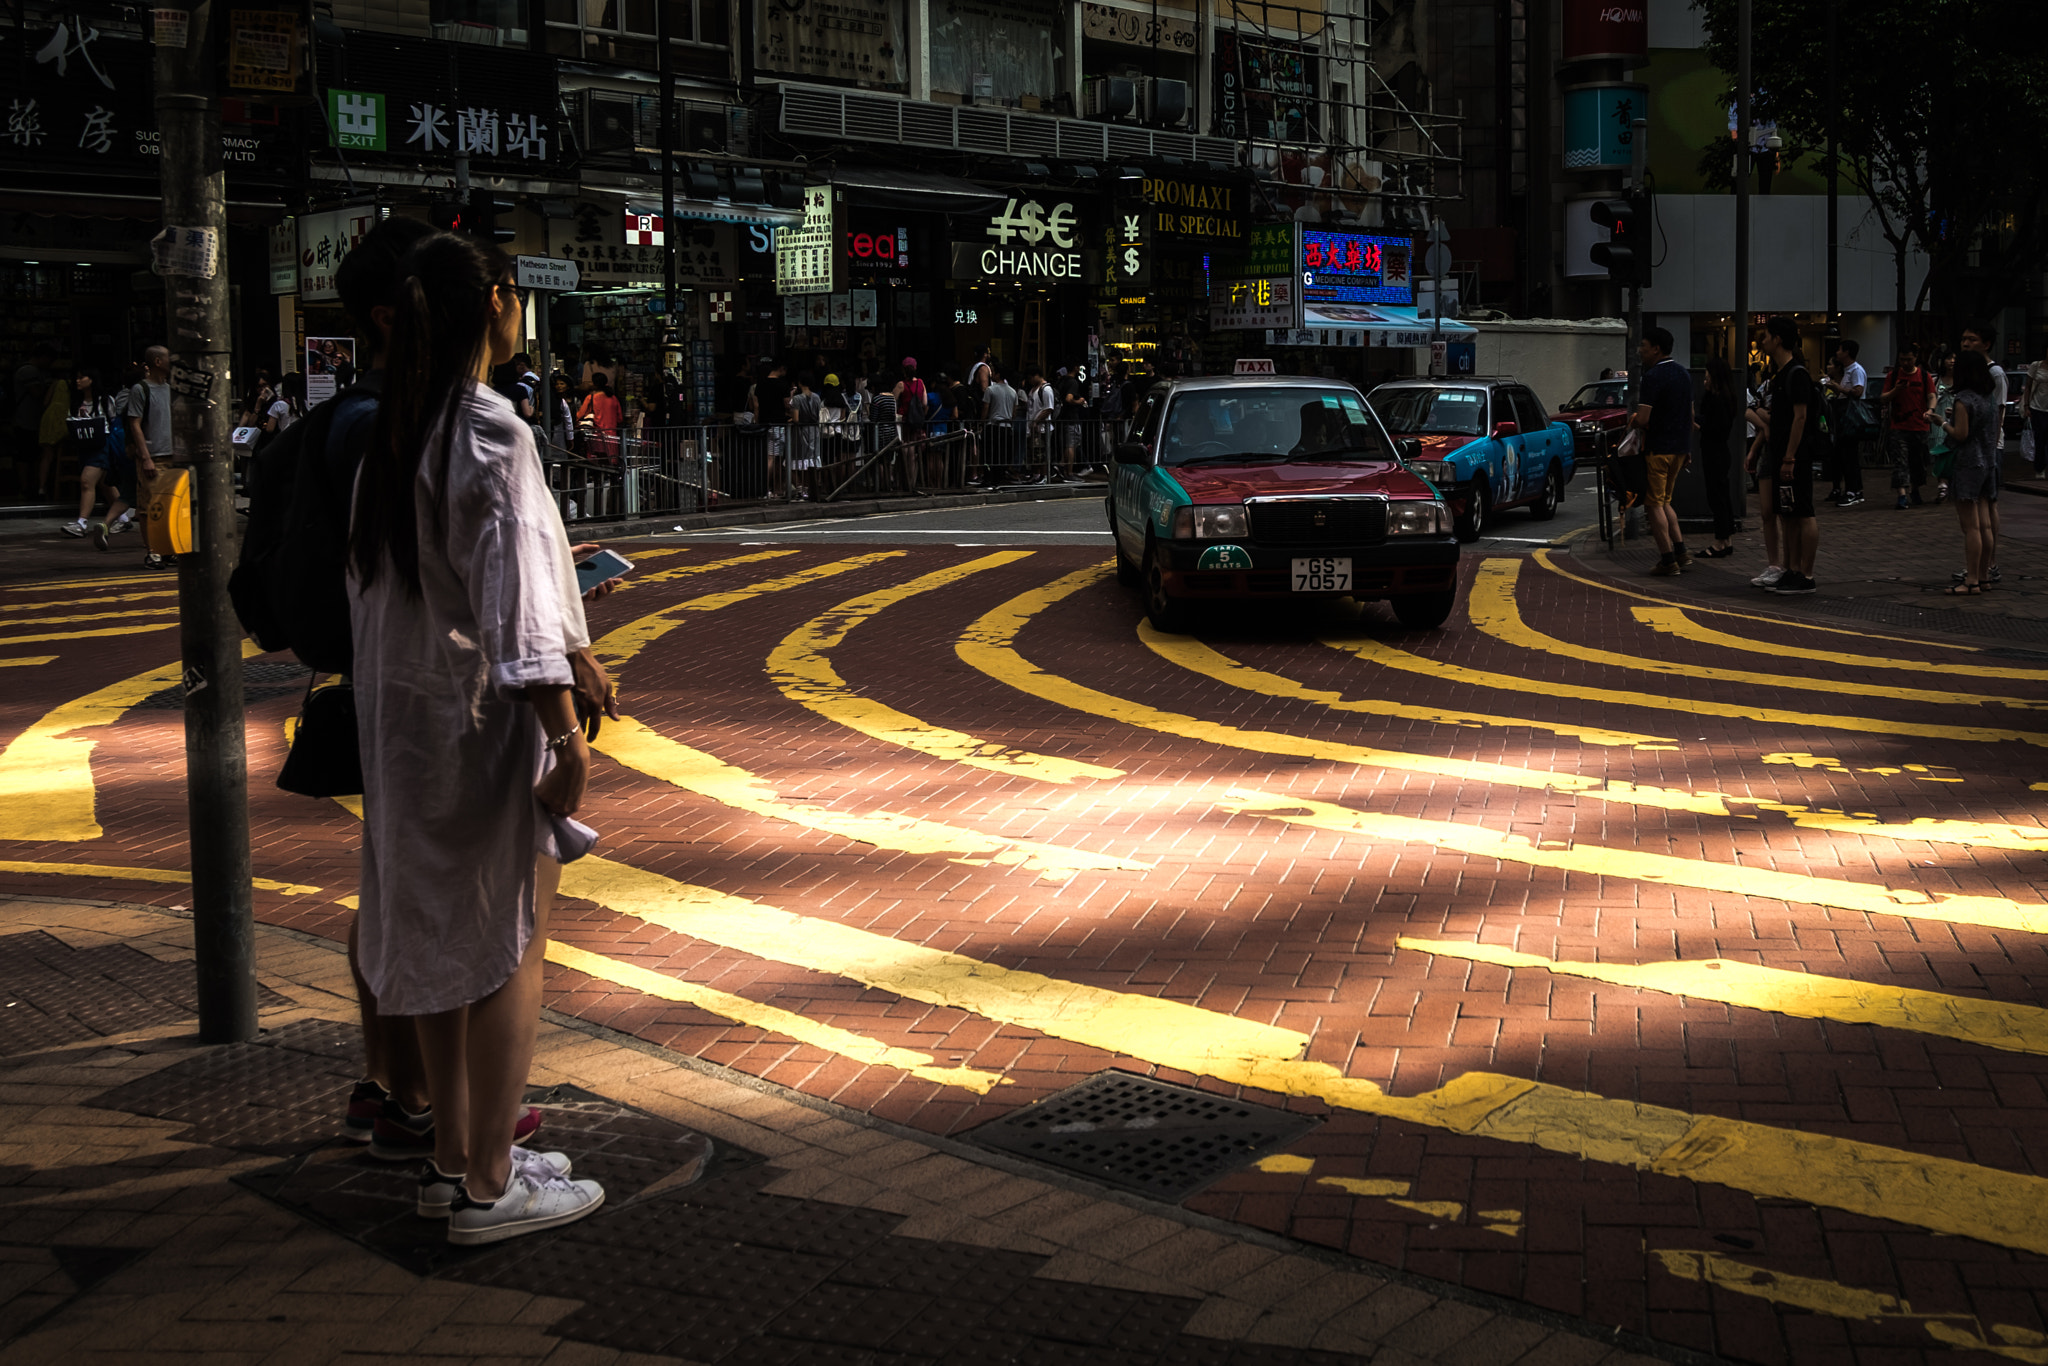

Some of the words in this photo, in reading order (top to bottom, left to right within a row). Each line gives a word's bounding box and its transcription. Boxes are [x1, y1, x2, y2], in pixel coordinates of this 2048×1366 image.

[1600, 7, 1644, 23] HONMA
[35, 14, 116, 91] 代
[135, 130, 161, 142] SUC
[222, 137, 261, 149] RMACY
[405, 102, 549, 161] 米蘭站
[338, 134, 377, 147] EXIT
[235, 151, 256, 161] LTD
[1142, 178, 1232, 211] PROMAXI
[1157, 212, 1175, 232] IR
[1179, 217, 1241, 239] SPECIAL
[520, 259, 548, 270] Matheson
[549, 262, 567, 271] Street
[613, 261, 665, 275] DISPENS
[981, 249, 1082, 278] CHANGE
[1123, 247, 1141, 276] $
[1302, 271, 1313, 285] G
[1315, 275, 1346, 285] MEDICINE
[1346, 276, 1379, 286] COMPANY
[1120, 296, 1147, 305] CHANGE
[1078, 365, 1087, 383] $
[1237, 360, 1272, 373] TAXI
[1219, 551, 1230, 562] 5
[1308, 558, 1335, 574] GS
[1295, 574, 1348, 590] 7057
